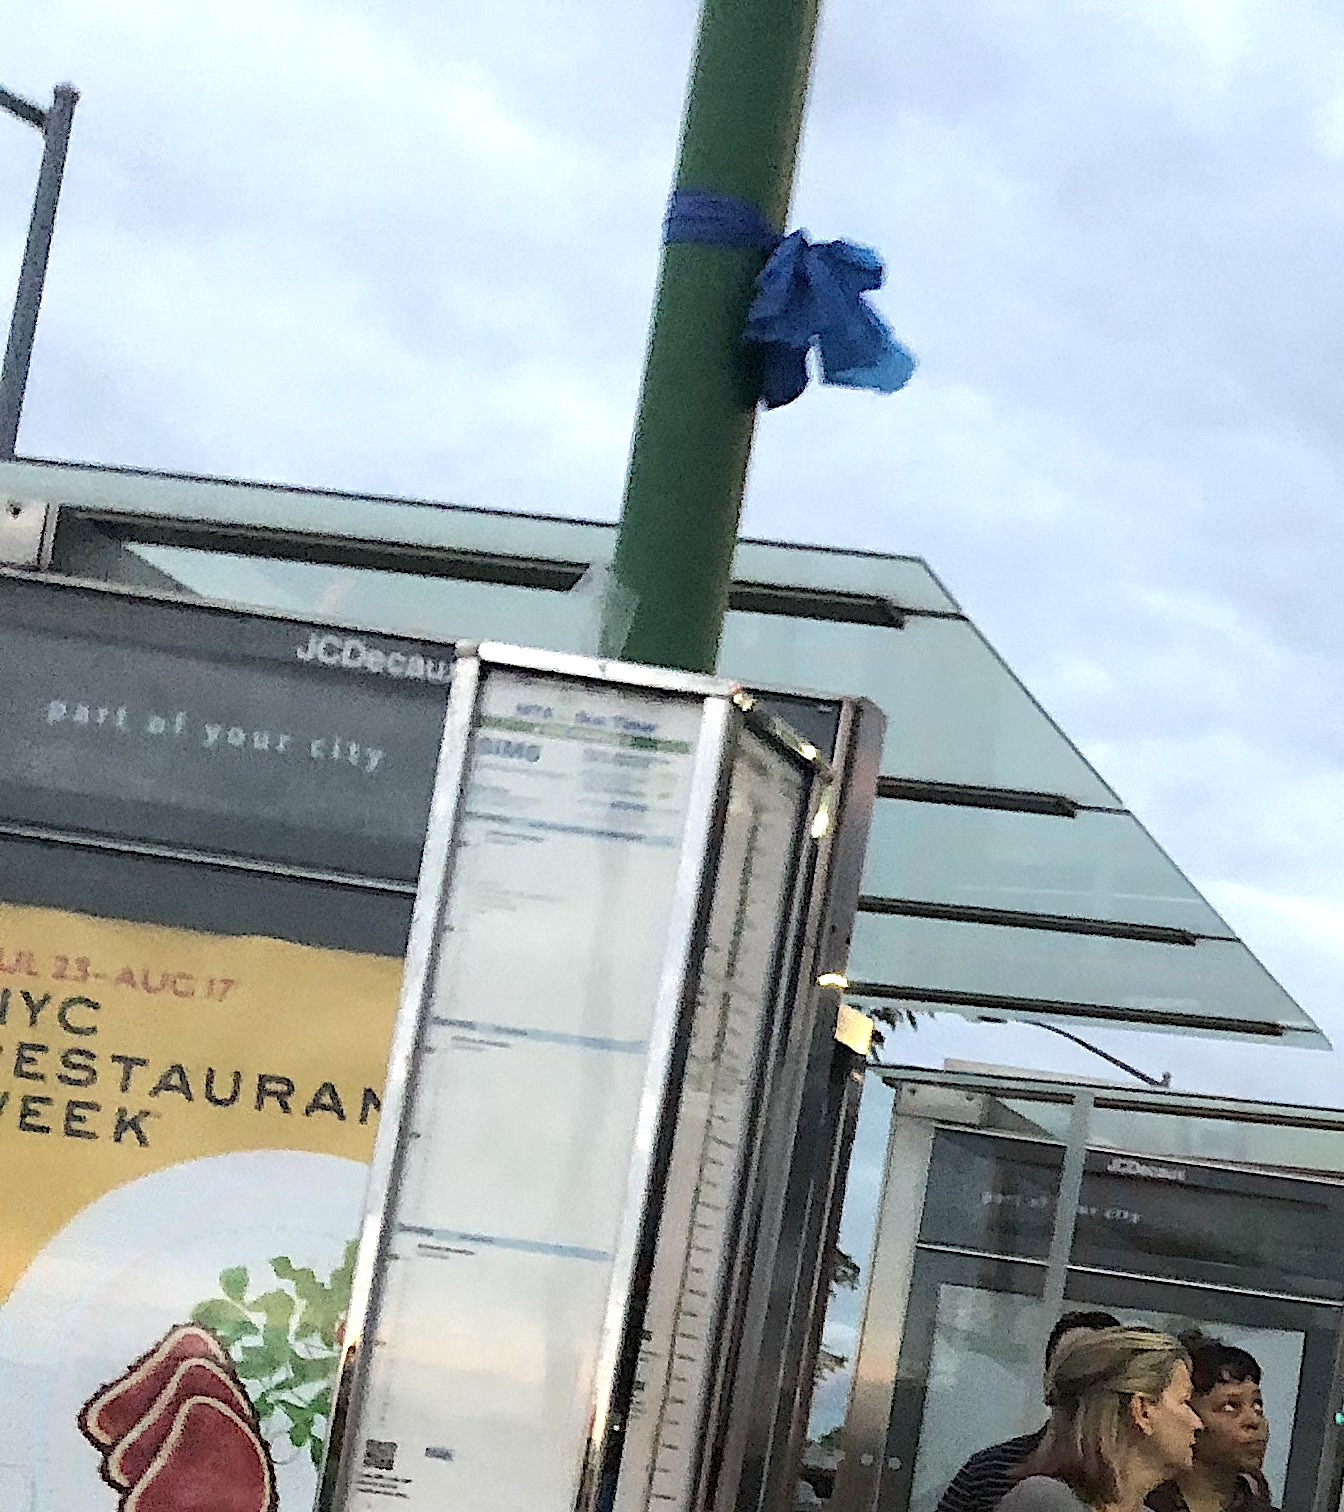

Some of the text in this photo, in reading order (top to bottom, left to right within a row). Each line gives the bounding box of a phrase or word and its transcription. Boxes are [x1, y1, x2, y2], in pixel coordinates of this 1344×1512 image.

[296, 632, 455, 684] JCDecau
[205, 722, 292, 752] your
[310, 736, 383, 773] city
[0, 1041, 382, 1125] ESTAURAN
[0, 1091, 159, 1147] EEK
